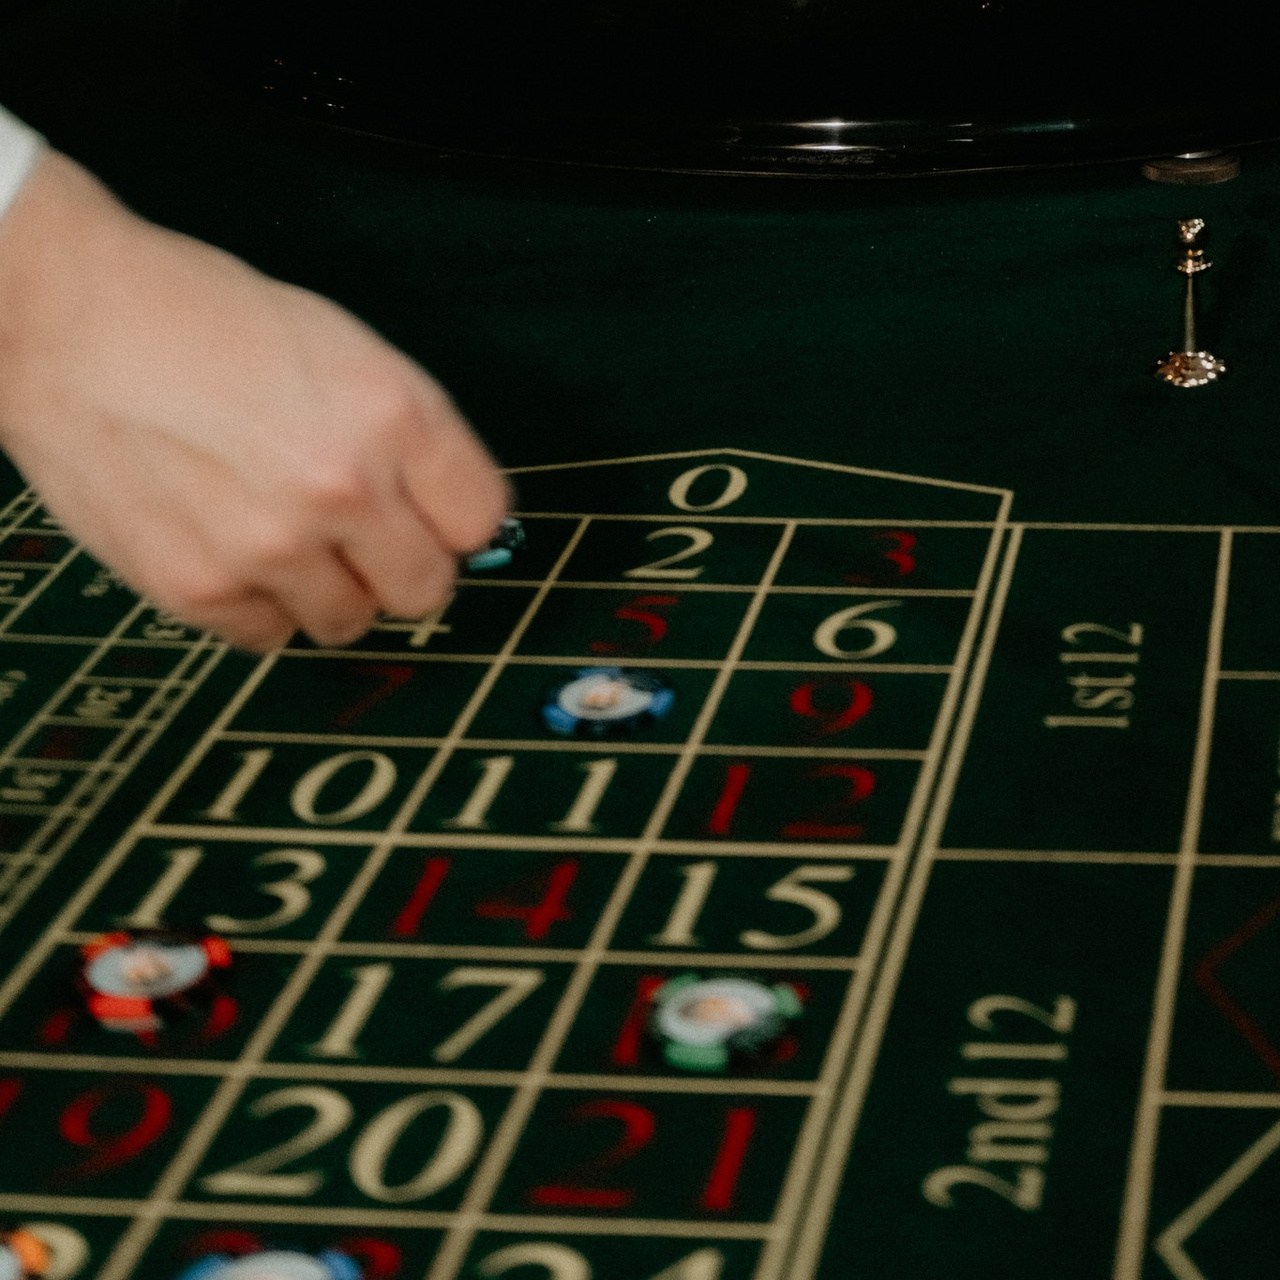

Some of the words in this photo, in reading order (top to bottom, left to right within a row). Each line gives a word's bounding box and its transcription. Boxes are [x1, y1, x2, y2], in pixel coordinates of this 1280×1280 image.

[668, 464, 748, 512] 0
[623, 526, 715, 579] 2
[843, 530, 917, 584] 3
[589, 595, 679, 653] 5
[812, 600, 902, 660] 6
[330, 666, 414, 726] 7
[789, 678, 874, 738] 9
[205, 749, 398, 824] 10
[442, 755, 618, 832] 11
[709, 763, 876, 839] 12
[118, 847, 326, 932] 13
[392, 857, 580, 940] 14
[652, 860, 856, 950] 15
[308, 964, 546, 1063] 17
[960, 994, 1078, 1061] 12
[200, 1086, 486, 1202] 20
[529, 1100, 756, 1212] 21
[922, 1077, 1062, 1211] 2nd
